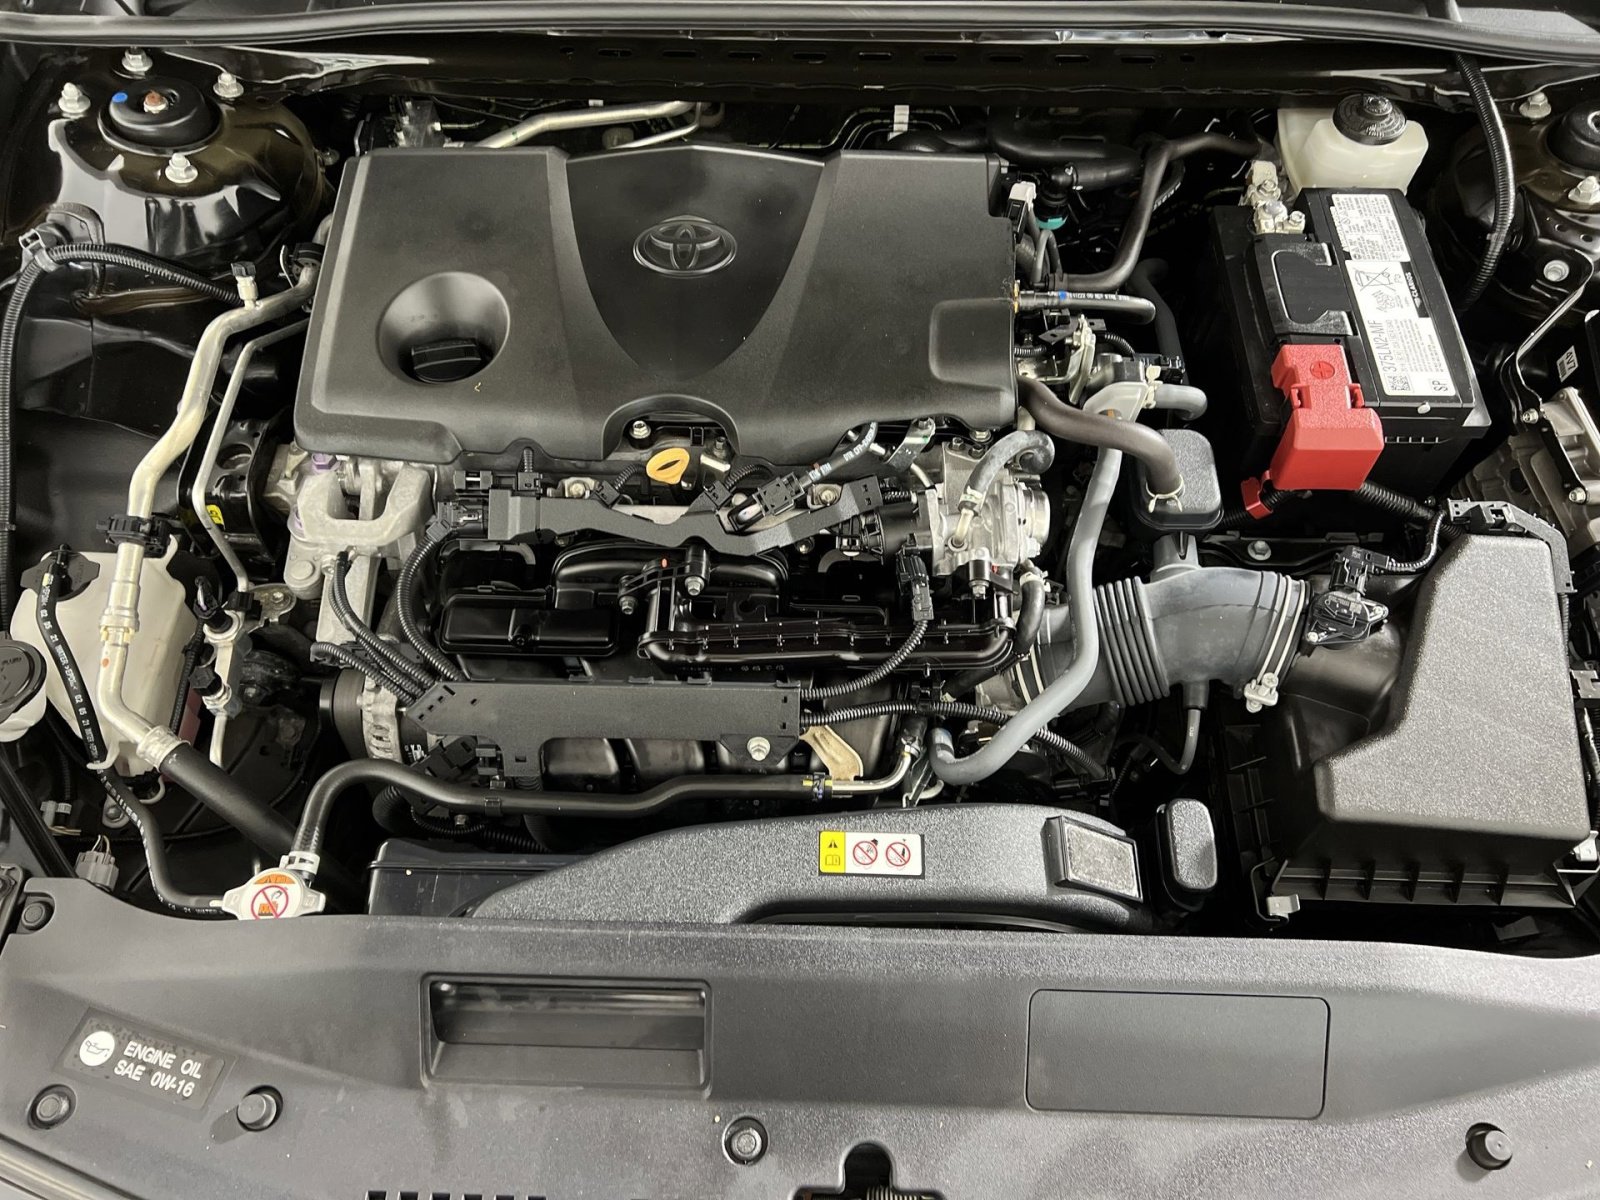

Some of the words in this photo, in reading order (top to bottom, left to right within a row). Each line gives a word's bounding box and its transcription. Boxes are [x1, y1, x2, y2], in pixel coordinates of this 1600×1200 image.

[1406, 271, 1419, 298] CLARIOS
[1367, 320, 1397, 372] 375LN2-MF
[1565, 351, 1576, 370] 4V7
[1431, 380, 1449, 392] SP
[74, 694, 83, 703] 02
[123, 1040, 177, 1070] ENGINE
[180, 1059, 202, 1079] OIL
[113, 1059, 146, 1082] SAE
[150, 1073, 195, 1098] 0W-16
